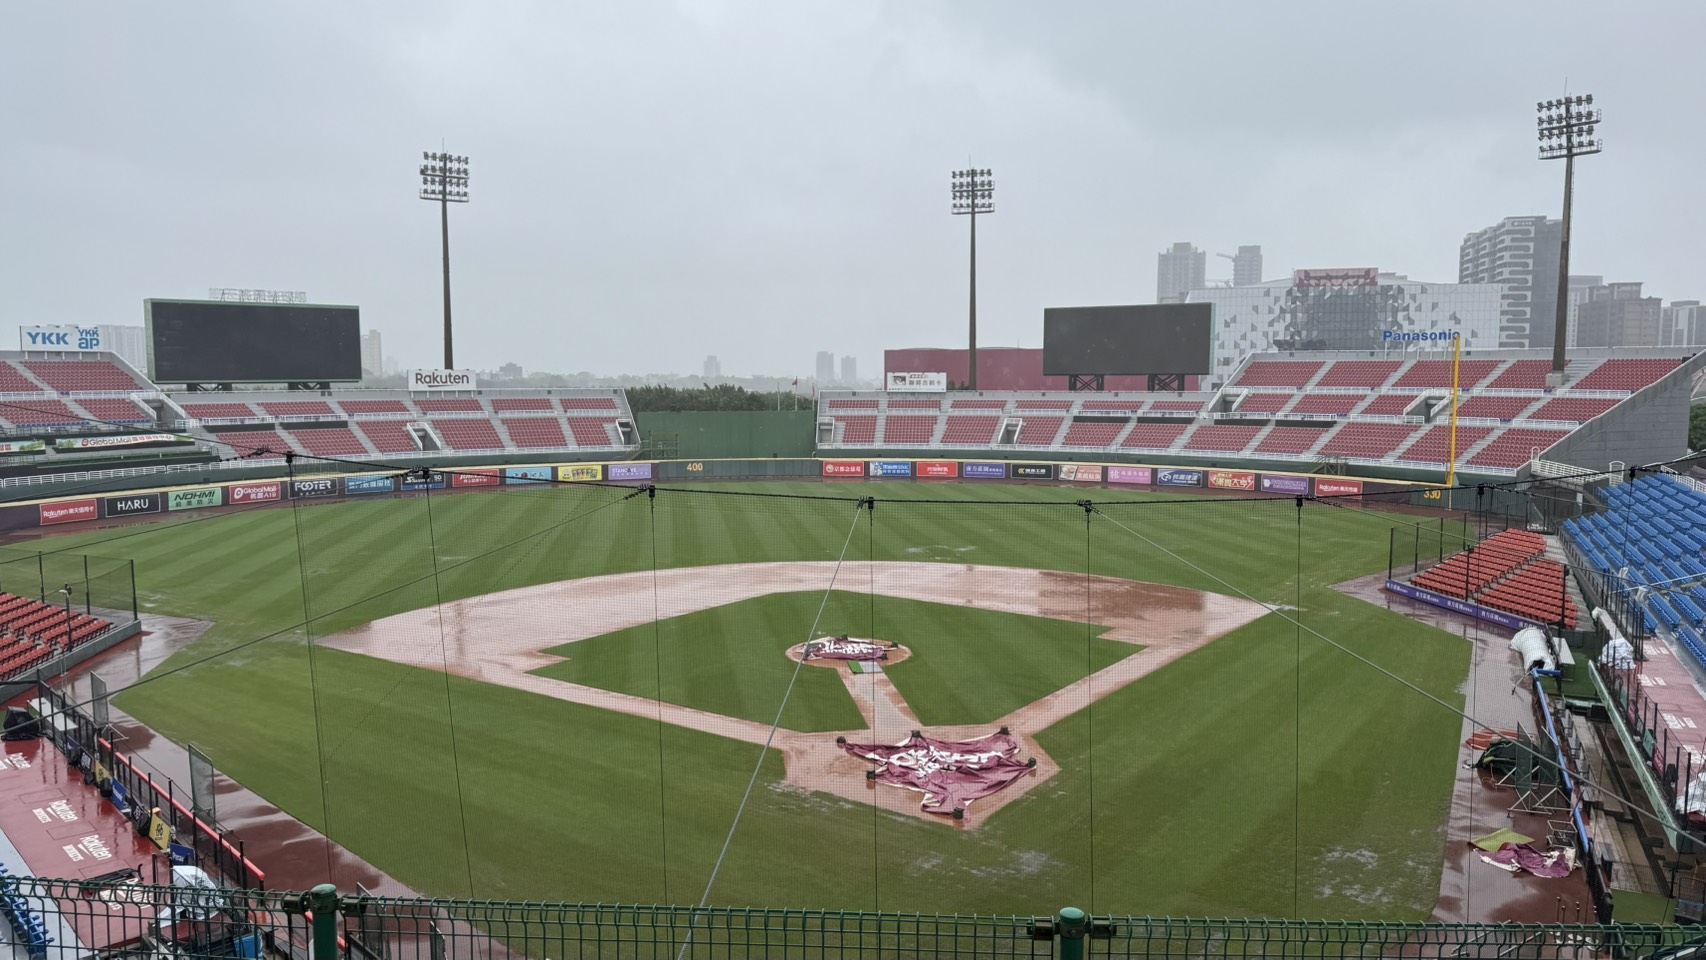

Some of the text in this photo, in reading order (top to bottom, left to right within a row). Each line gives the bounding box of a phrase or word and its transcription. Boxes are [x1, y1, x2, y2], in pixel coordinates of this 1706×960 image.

[27, 331, 69, 345] YKK
[78, 329, 99, 338] YKK
[1383, 329, 1460, 341] Panasonic
[78, 337, 100, 349] ap
[415, 372, 470, 387] Rakuten
[687, 463, 703, 471] 400
[294, 480, 332, 491] FOOTER
[174, 490, 215, 501] NOHMI
[1423, 488, 1442, 499] 330
[117, 498, 149, 511] HARU
